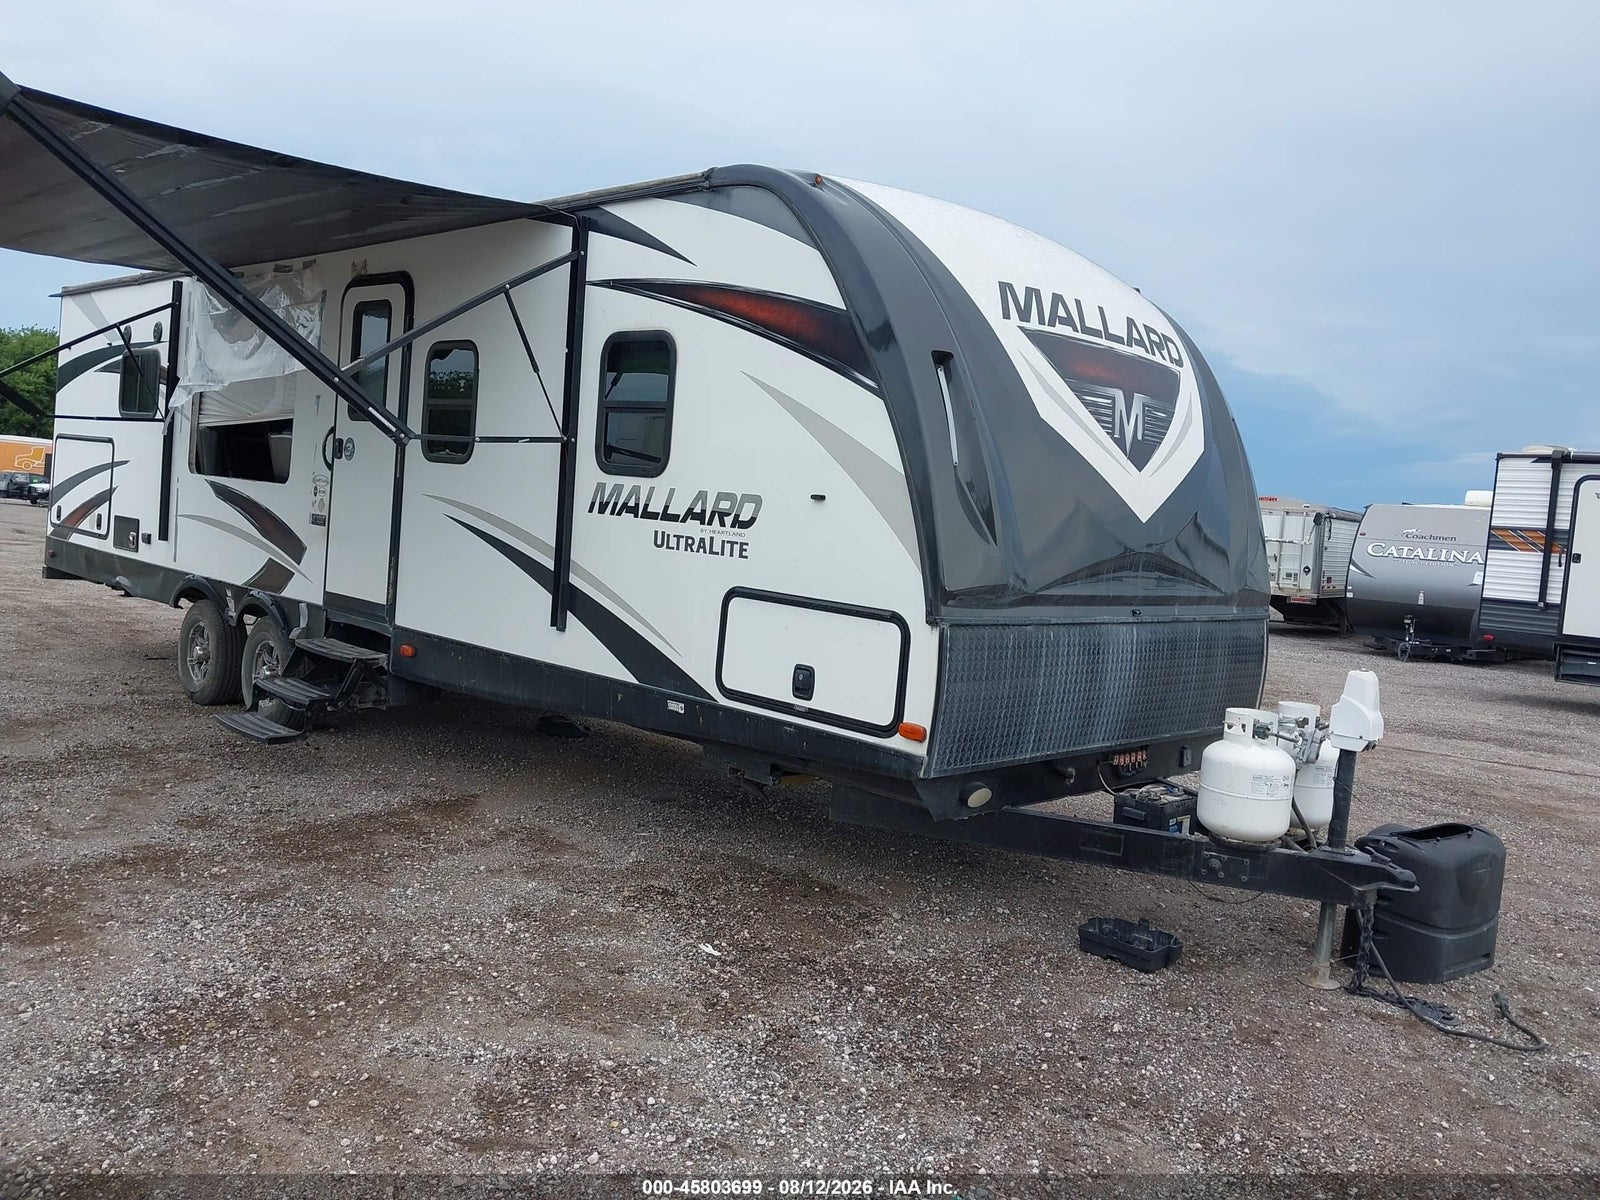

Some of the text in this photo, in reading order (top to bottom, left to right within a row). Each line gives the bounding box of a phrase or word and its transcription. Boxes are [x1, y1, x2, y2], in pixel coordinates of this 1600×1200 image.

[998, 281, 1185, 368] MALLARD
[587, 481, 763, 530] MALLARD
[709, 529, 746, 538] HEARTLAND
[1405, 532, 1457, 542] Coachmen
[1366, 542, 1485, 564] CATALINA
